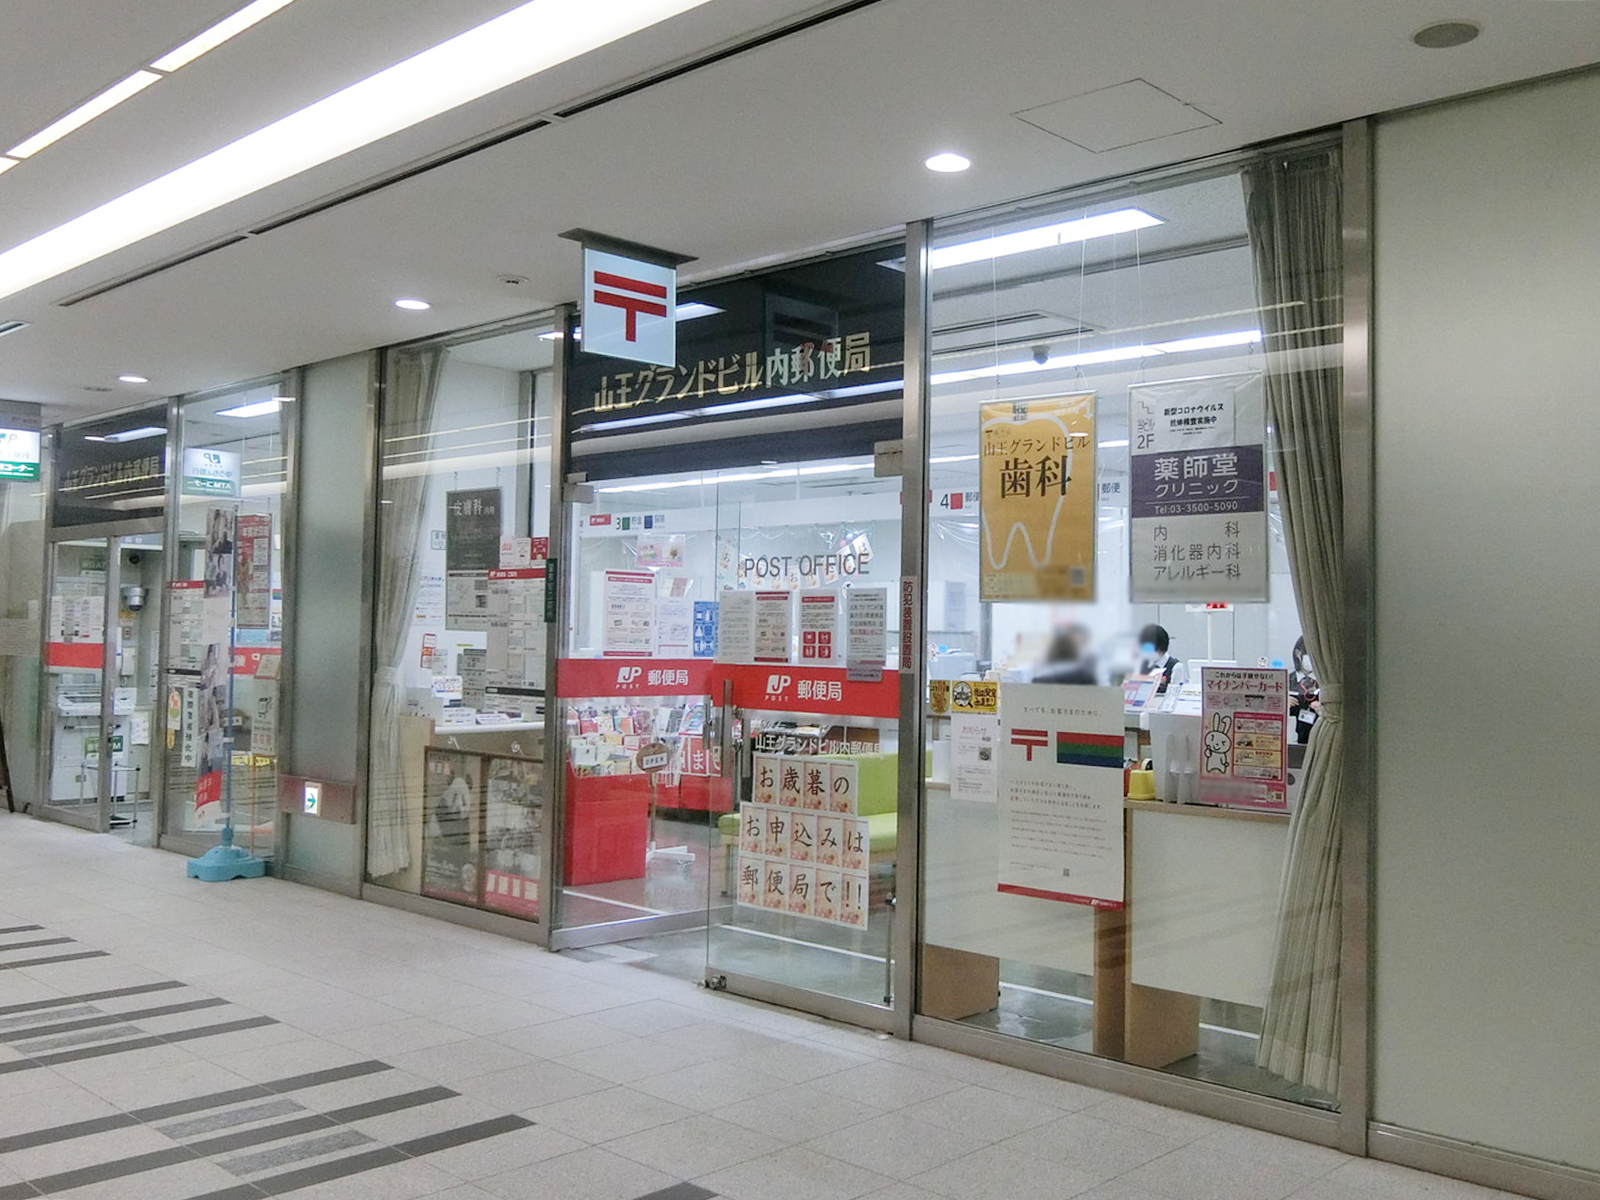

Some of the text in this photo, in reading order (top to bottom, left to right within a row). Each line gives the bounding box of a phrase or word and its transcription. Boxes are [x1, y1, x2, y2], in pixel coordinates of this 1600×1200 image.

[593, 331, 872, 412] 山王グランドビル内郵便局
[1164, 403, 1224, 416] 新型コロナウイルス
[983, 436, 1090, 457] 山王グランドビル
[1137, 434, 1155, 449] 2F
[1154, 453, 1239, 480] 薬師堂
[999, 455, 1072, 498] 歯科
[1101, 482, 1121, 494] 郵便
[1154, 479, 1239, 498] クリニック
[940, 493, 949, 509] 4
[1154, 501, 1238, 516] Tel:03-3500-5090
[615, 517, 622, 530] 3
[1153, 521, 1240, 541] 内 科
[1153, 543, 1241, 562] 消化器内科
[744, 553, 870, 578] POST OFFICE
[1153, 564, 1241, 581] アレルギー科
[902, 580, 914, 670] 防犯装置設置局
[617, 666, 689, 687] JP 郵便局
[1205, 679, 1283, 693] マイナンバーカード
[766, 674, 843, 702] JP 郵便局
[764, 694, 790, 702] POST
[644, 755, 665, 767] OPEN
[759, 765, 850, 797] お歳暮の
[746, 815, 864, 855] お申込みは
